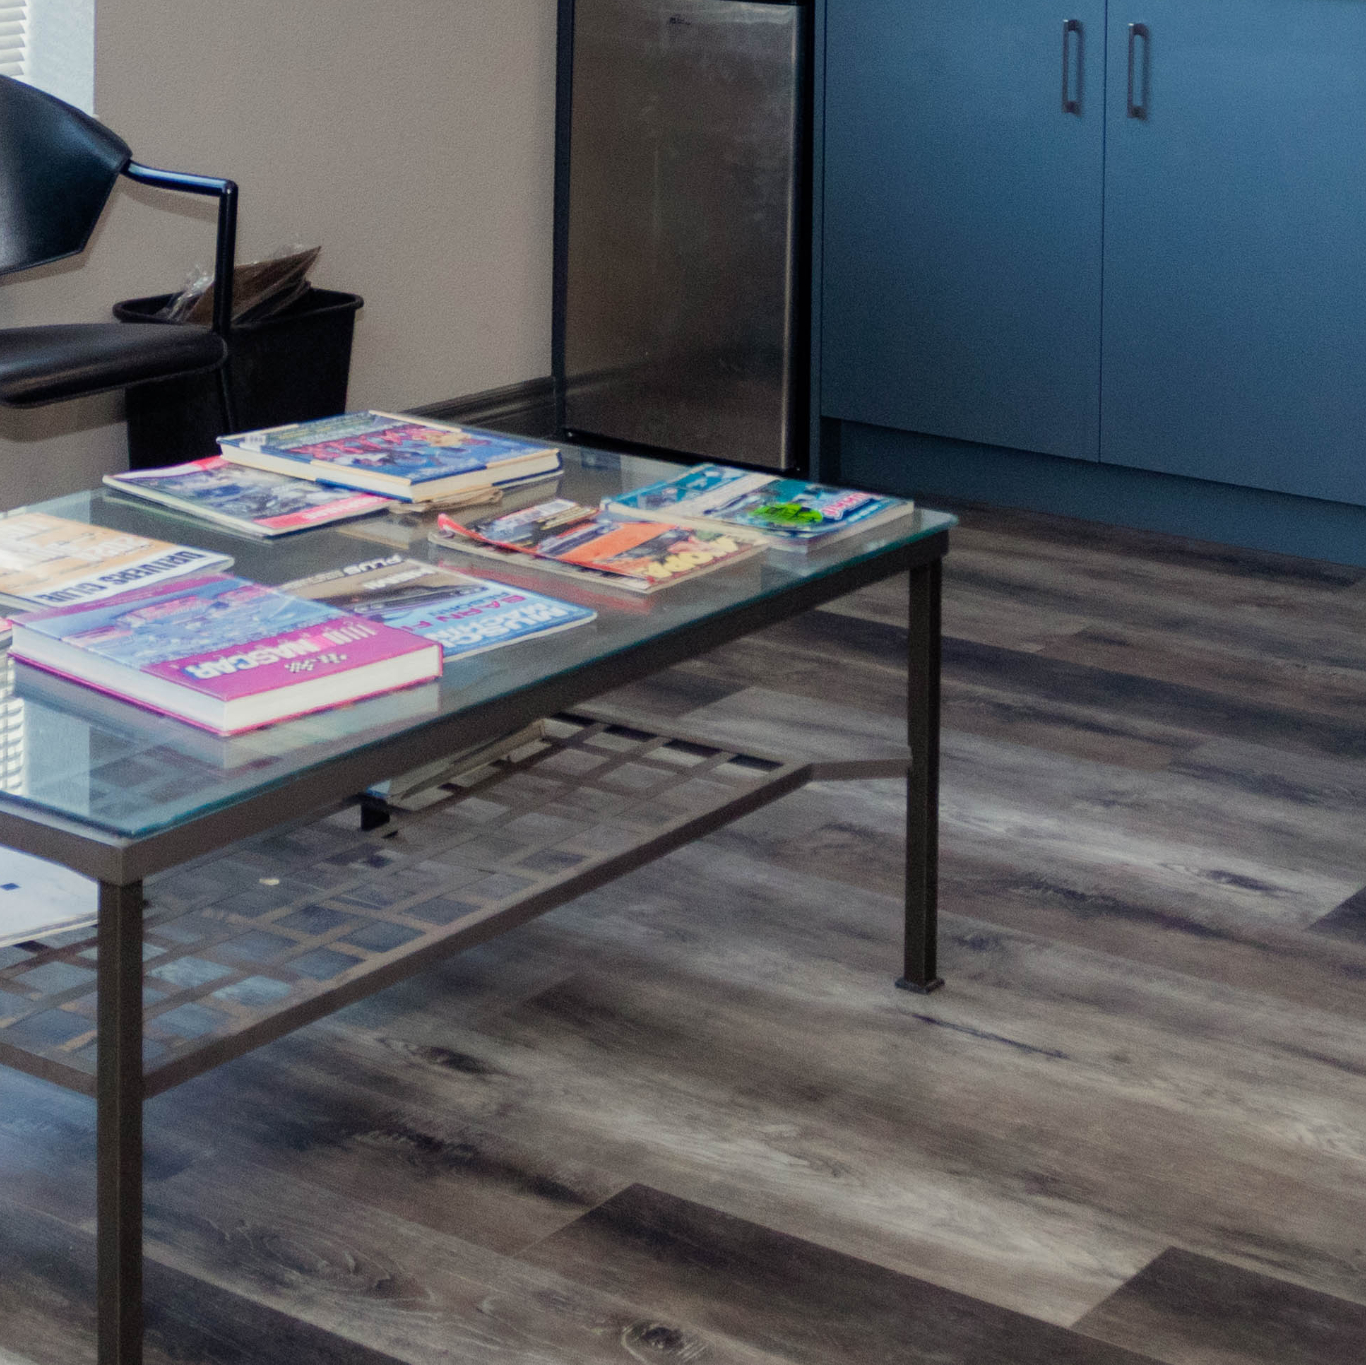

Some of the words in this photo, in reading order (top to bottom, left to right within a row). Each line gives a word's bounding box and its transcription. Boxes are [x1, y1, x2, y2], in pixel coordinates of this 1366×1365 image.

[99, 550, 206, 585] DRIVERS
[35, 581, 100, 603] CLUB
[184, 637, 322, 681] NASCAR
